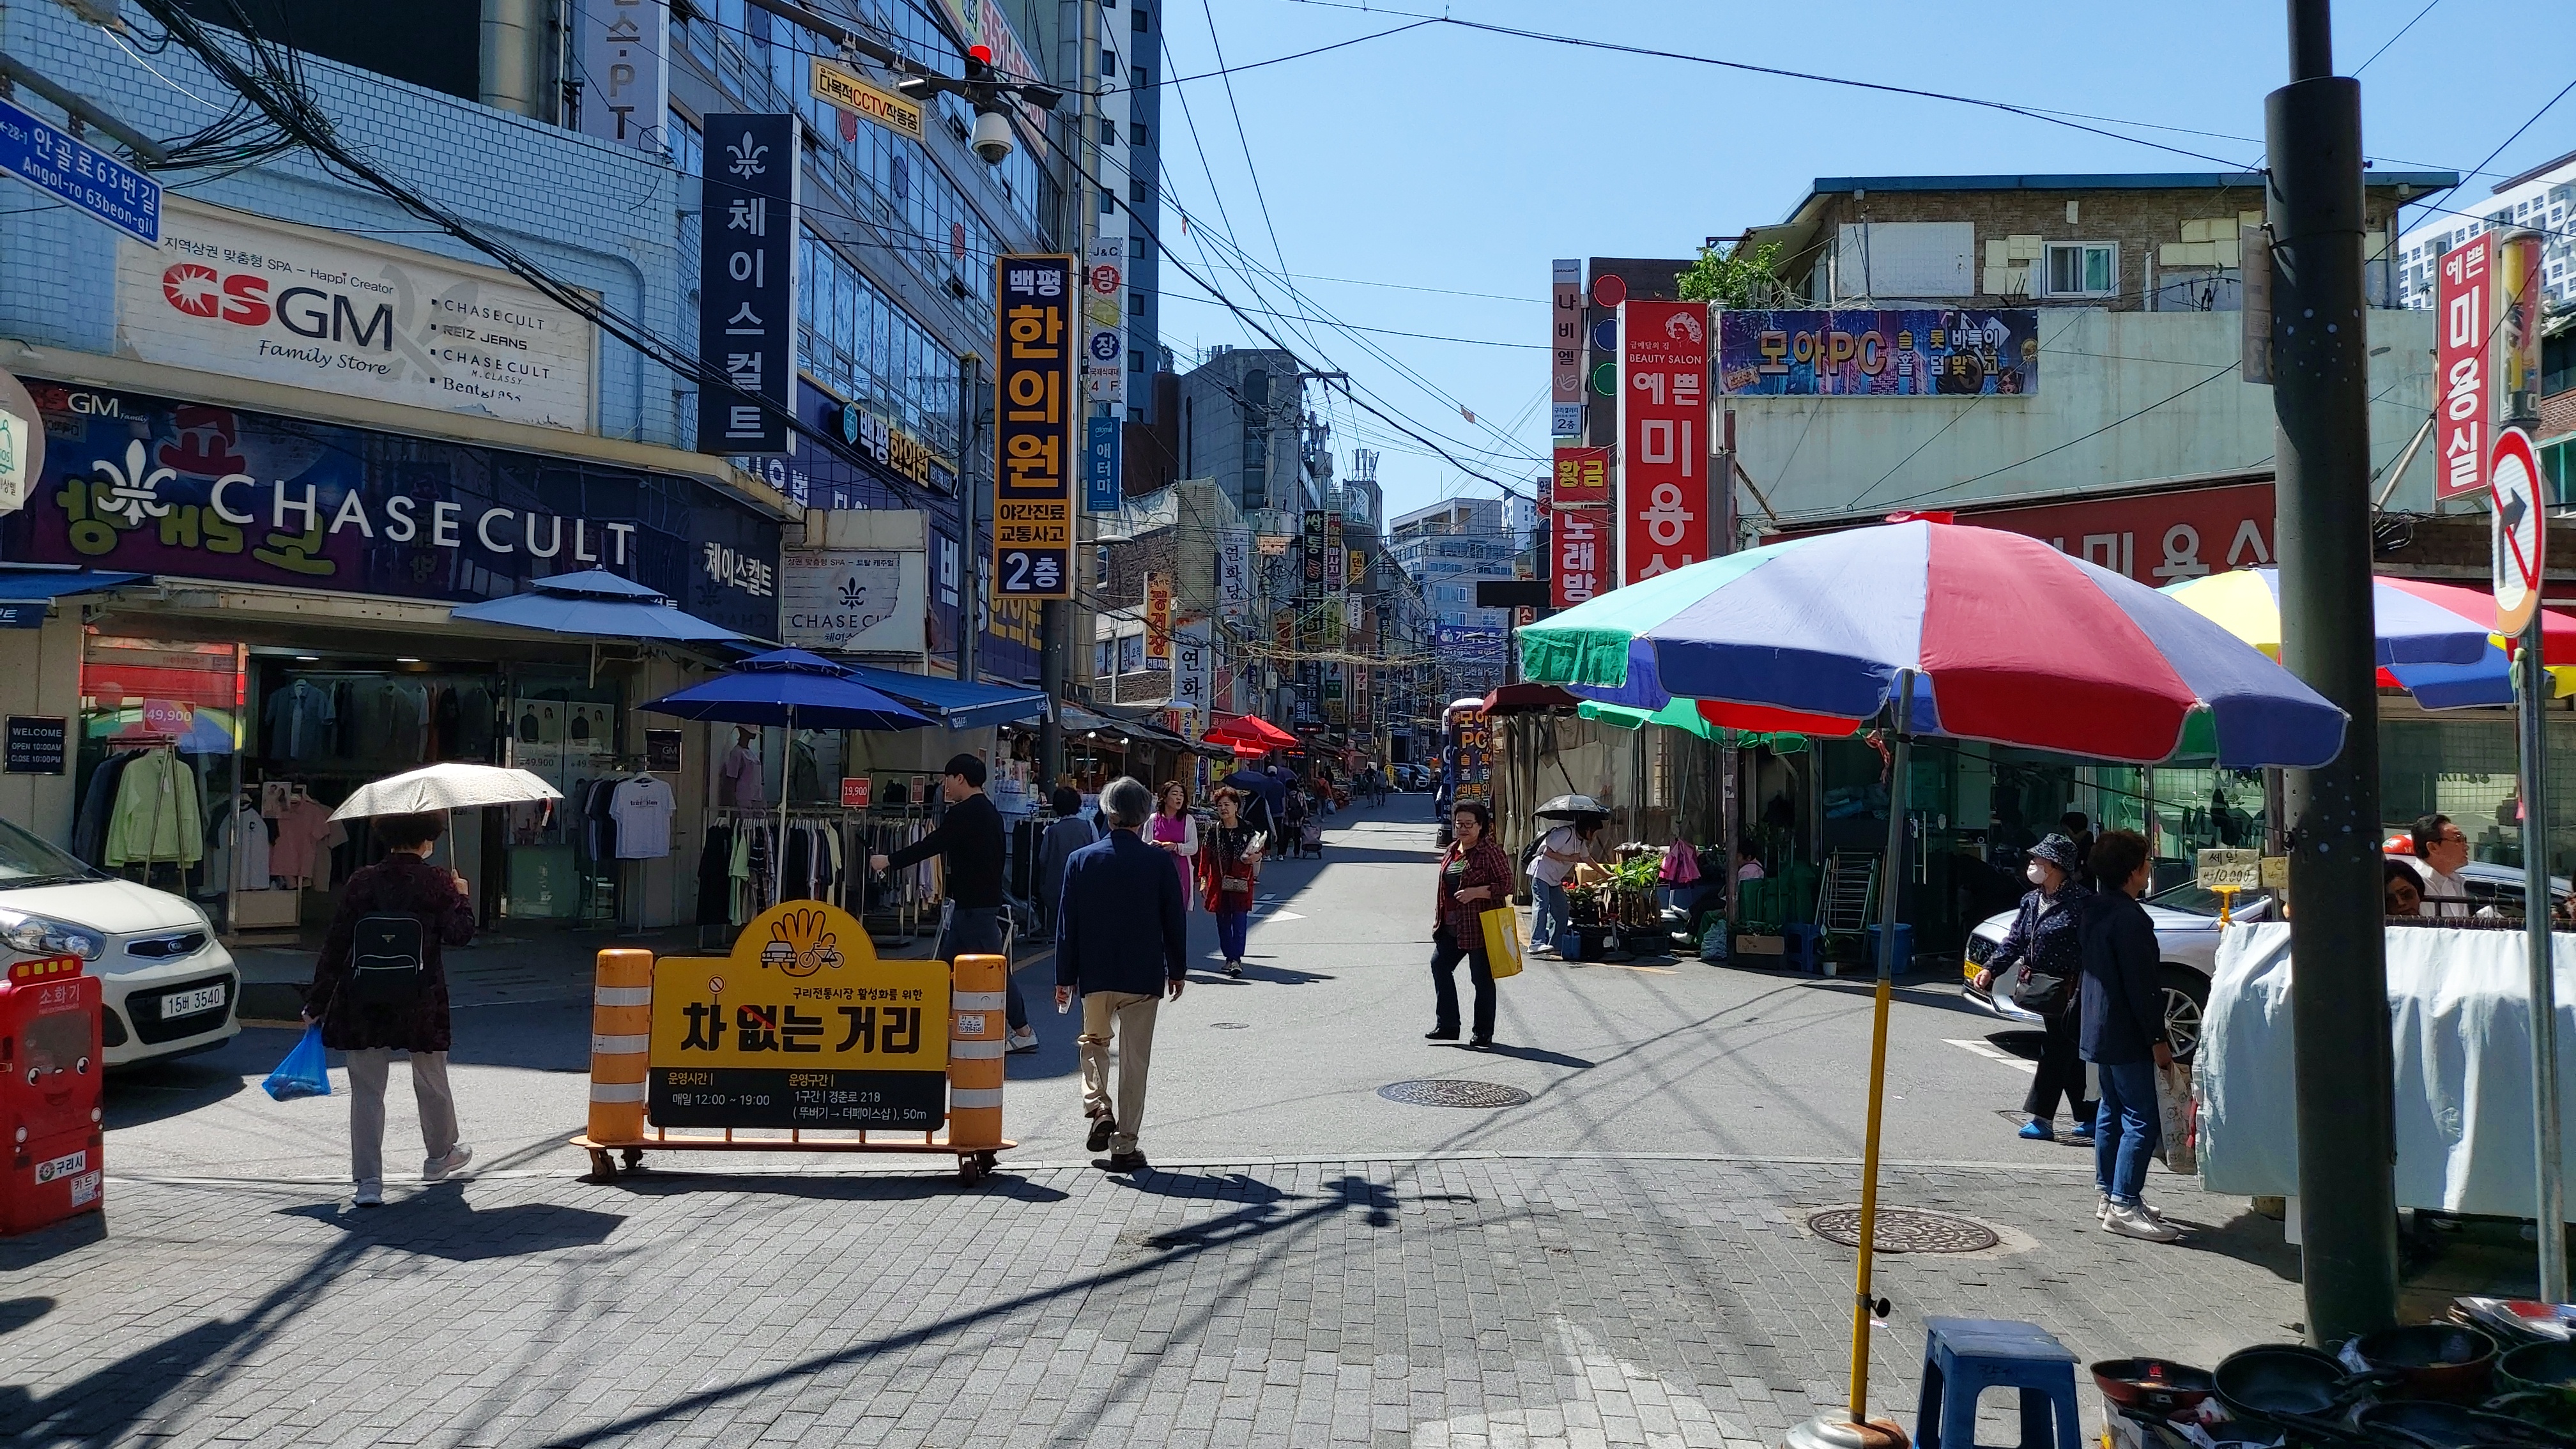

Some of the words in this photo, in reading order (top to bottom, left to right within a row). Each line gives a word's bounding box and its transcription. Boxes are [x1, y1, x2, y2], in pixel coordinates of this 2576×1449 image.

[33, 127, 155, 217] 안골로63번길
[22, 156, 82, 199] Angol-ro
[86, 188, 154, 236] 63beon-gil
[1093, 246, 1118, 257] J&C
[164, 236, 219, 258] 지역상권
[224, 247, 263, 268] 맞춤형
[267, 258, 293, 274] SPA
[310, 267, 348, 287] Happi
[350, 275, 394, 295] Creator
[2446, 243, 2485, 286] 예쁜
[1009, 269, 1061, 297] 백평
[445, 300, 545, 330] CHASECULT
[725, 196, 765, 438] 체이스컬트
[1096, 269, 1116, 357] 당구장
[480, 334, 527, 351] JEANS
[1558, 294, 1577, 366] 나비엘
[1952, 328, 2001, 350] 바둑이
[257, 339, 332, 368] Family
[338, 353, 391, 376] Store
[443, 349, 550, 379] CHASECULT
[1629, 353, 1664, 364] BEAUTY
[1668, 354, 1702, 365] SALON
[1758, 330, 1888, 376] 모아PC
[1008, 304, 1063, 489] 한의원
[1632, 372, 1700, 406] 예쁜
[2446, 285, 2480, 488] 미용실
[67, 392, 119, 418] GM
[1557, 418, 1575, 431] 2층
[1096, 443, 1111, 494] 애터미
[1558, 459, 1605, 488] 황금
[210, 473, 636, 565] CHASECULT
[999, 503, 1066, 521] 야간진료
[999, 526, 1064, 542] 교통사고
[703, 541, 773, 597] 체이스컬트
[1563, 512, 1598, 602] 노래방
[1006, 551, 1060, 591] 2층
[1225, 546, 1242, 599] 연화당
[146, 709, 192, 722] 49,900
[12, 727, 63, 737] WELCOME
[1461, 731, 1488, 749] PC
[10, 755, 30, 763] CLOSE
[32, 755, 61, 763] 10:00PM
[11, 742, 31, 751] OPEN
[33, 743, 62, 751] 10:00AM
[662, 746, 677, 755] GM
[843, 785, 868, 797] 19,900
[1460, 784, 1490, 795] 바둑이
[39, 983, 81, 1006] 소화기
[168, 993, 190, 1013] 15버
[194, 988, 220, 1008] 3540
[792, 986, 854, 1000] 구리전통시장
[857, 987, 898, 1001] 활성화를
[901, 988, 923, 1001] 위한
[680, 1002, 728, 1052] 차
[736, 1004, 824, 1053] 없는
[836, 1006, 922, 1054] 거리
[667, 1072, 708, 1085] 운영시간
[788, 1073, 828, 1087] 운영구간
[672, 1093, 692, 1106] 매일
[695, 1094, 726, 1105] 12:00
[739, 1094, 770, 1106] 19:00
[795, 1091, 820, 1103] 1구간
[829, 1090, 858, 1103] 경춘로
[861, 1092, 881, 1103] 218
[903, 1109, 927, 1120] 50m
[56, 1156, 83, 1176] 구리시
